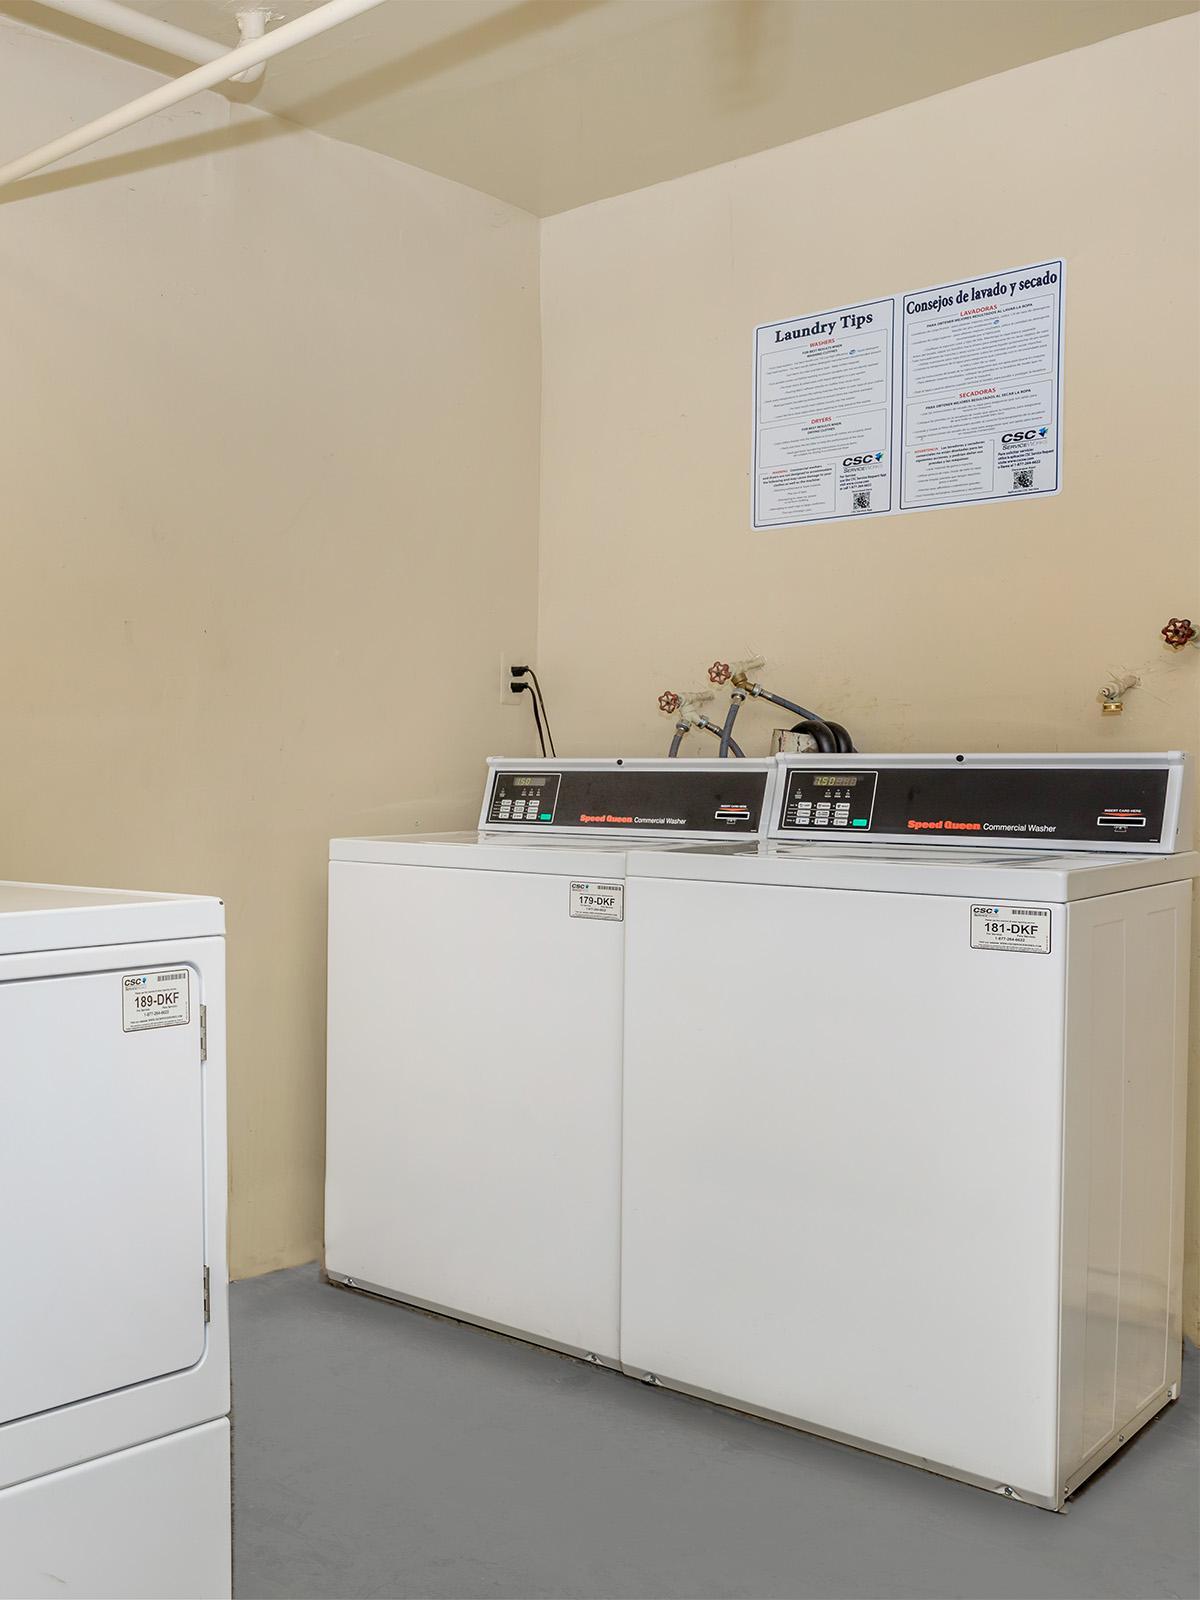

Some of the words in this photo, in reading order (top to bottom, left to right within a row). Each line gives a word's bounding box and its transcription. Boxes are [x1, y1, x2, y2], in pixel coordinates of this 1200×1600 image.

[906, 295, 953, 315] Consejos
[956, 290, 969, 304] de
[971, 282, 1007, 301] lavado
[1010, 282, 1017, 297] y
[1018, 270, 1058, 290] secado
[960, 304, 998, 316] LAVADORAS
[774, 321, 836, 343] Laundry
[840, 313, 873, 329] Tips
[959, 387, 997, 398] SECADORAS
[1001, 429, 1037, 443] CSC
[842, 454, 873, 467] CSC
[580, 814, 606, 823] Speed
[606, 815, 633, 824] Queen
[634, 816, 665, 824] Commercial
[666, 817, 687, 825] Washer
[907, 820, 943, 830] Speed
[944, 821, 981, 831] Queen
[983, 822, 1026, 832] Commercial
[1028, 824, 1056, 833] Washer
[579, 896, 616, 906] 179-DKF
[984, 922, 1039, 935] 181-DKF
[124, 978, 142, 987] CSC
[134, 992, 179, 1008] 189-DKF
